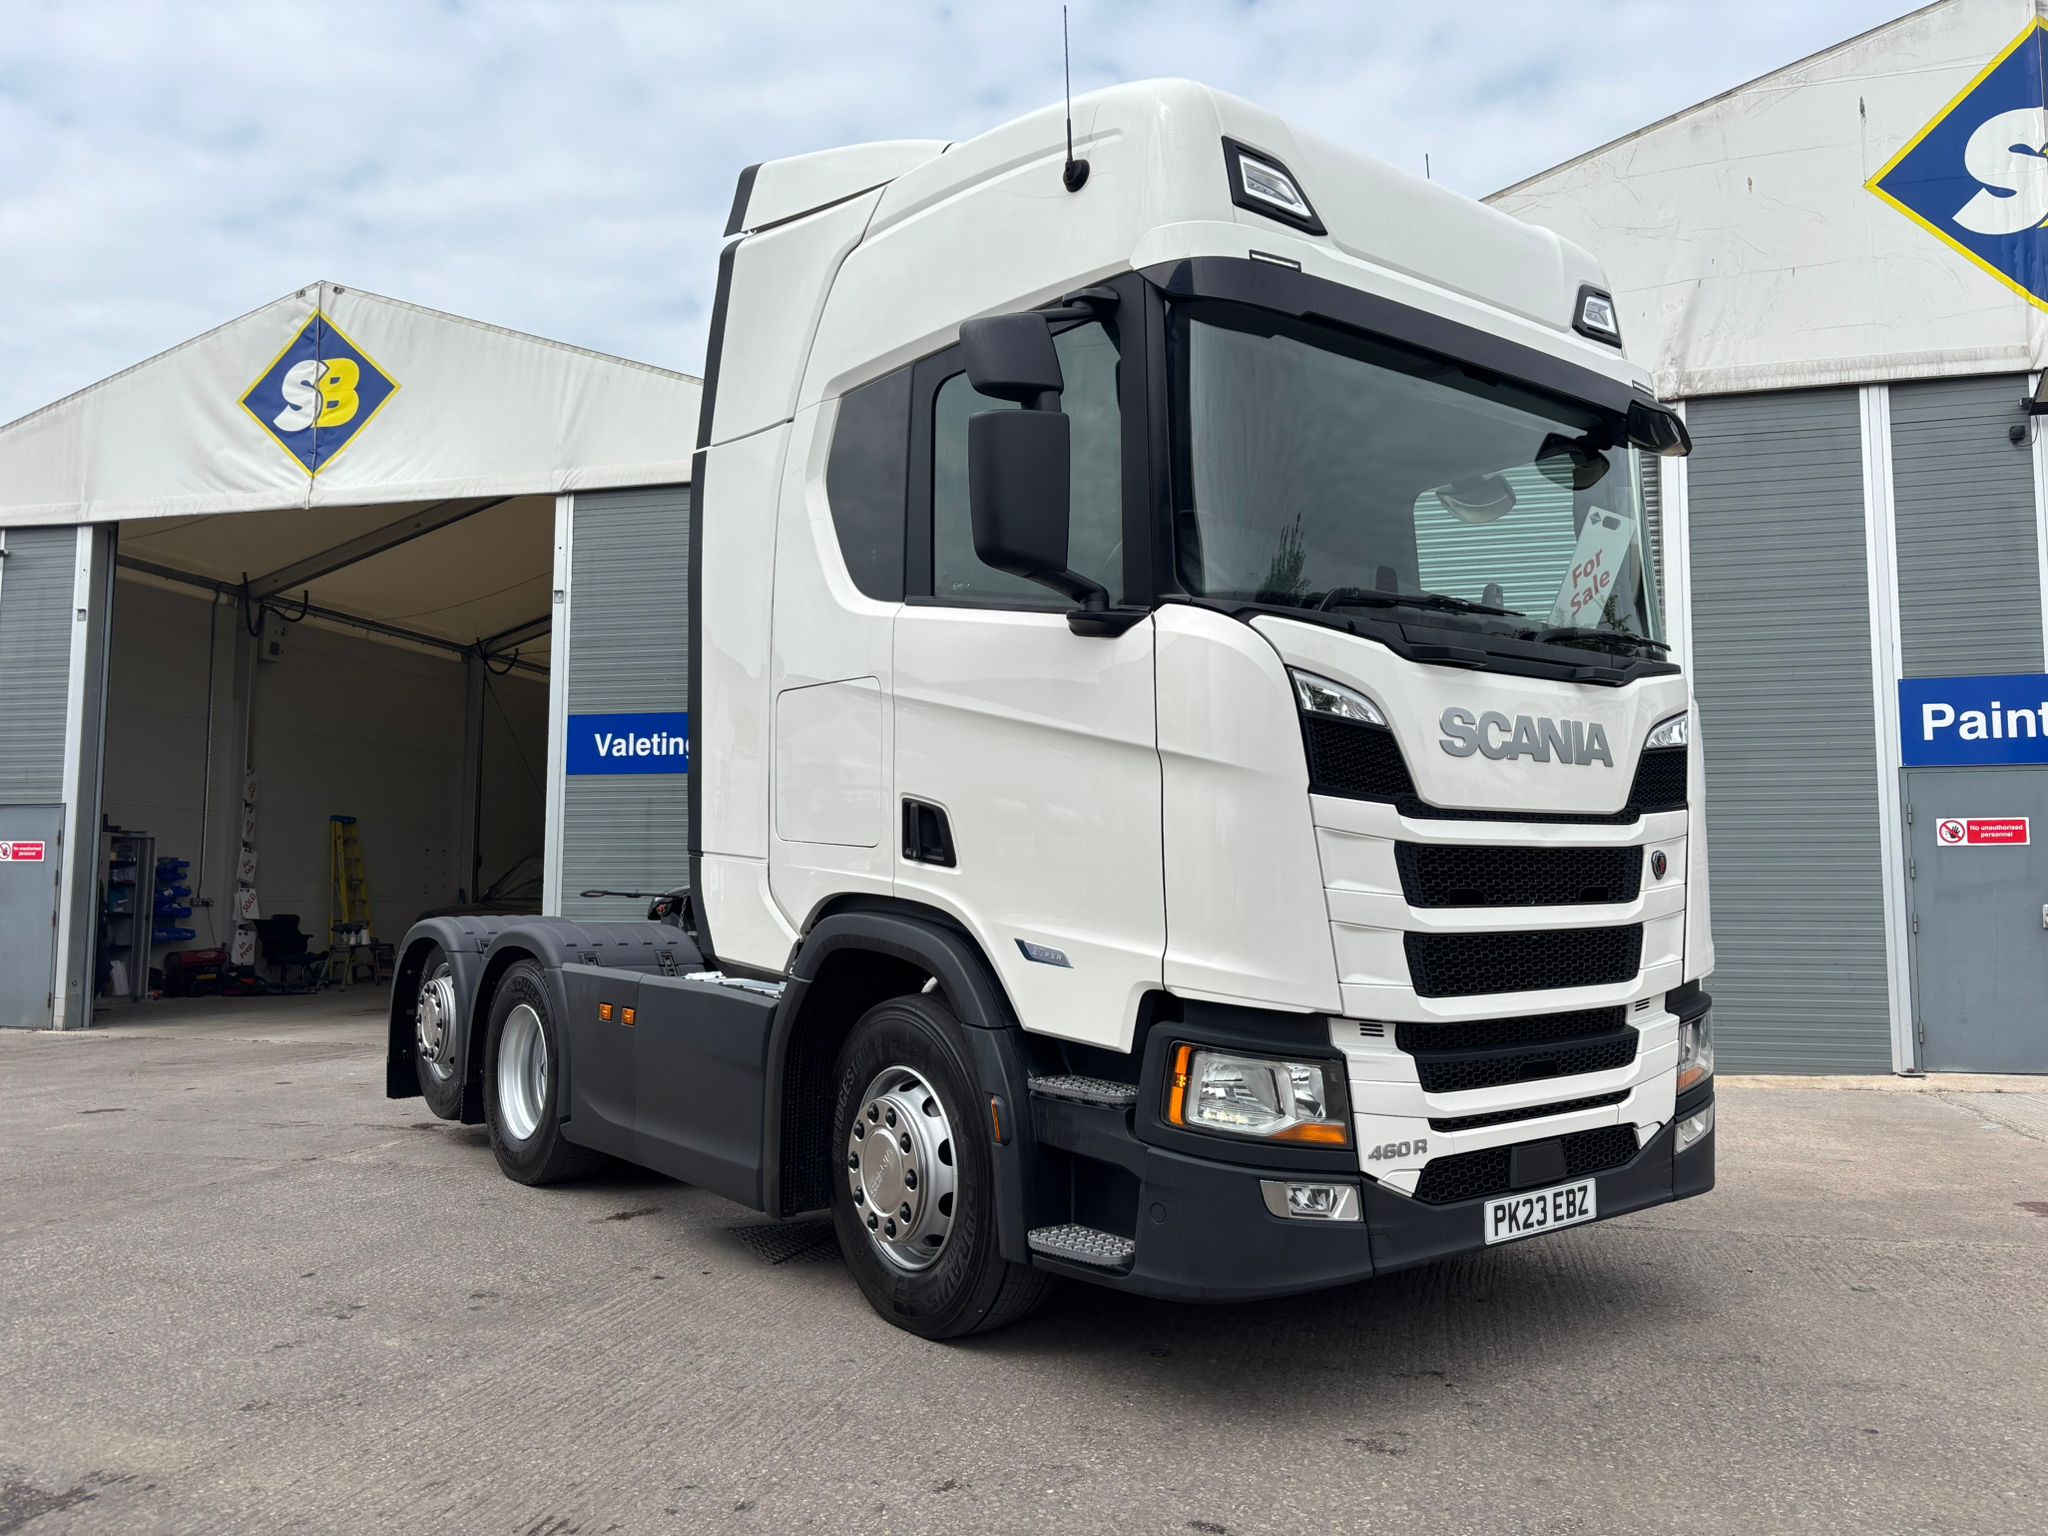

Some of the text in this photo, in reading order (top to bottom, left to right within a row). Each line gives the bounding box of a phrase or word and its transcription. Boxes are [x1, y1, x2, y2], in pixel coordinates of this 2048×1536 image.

[1952, 106, 2048, 235] S
[272, 358, 360, 432] SB
[1572, 548, 1602, 589] For
[1571, 570, 1610, 617] Sale
[594, 731, 689, 759] Valetin
[1439, 707, 1614, 767] SCANIA
[243, 893, 256, 912] SOLD
[1368, 1138, 1428, 1160] 460 R
[1494, 1185, 1589, 1237] PK23 EBZ
